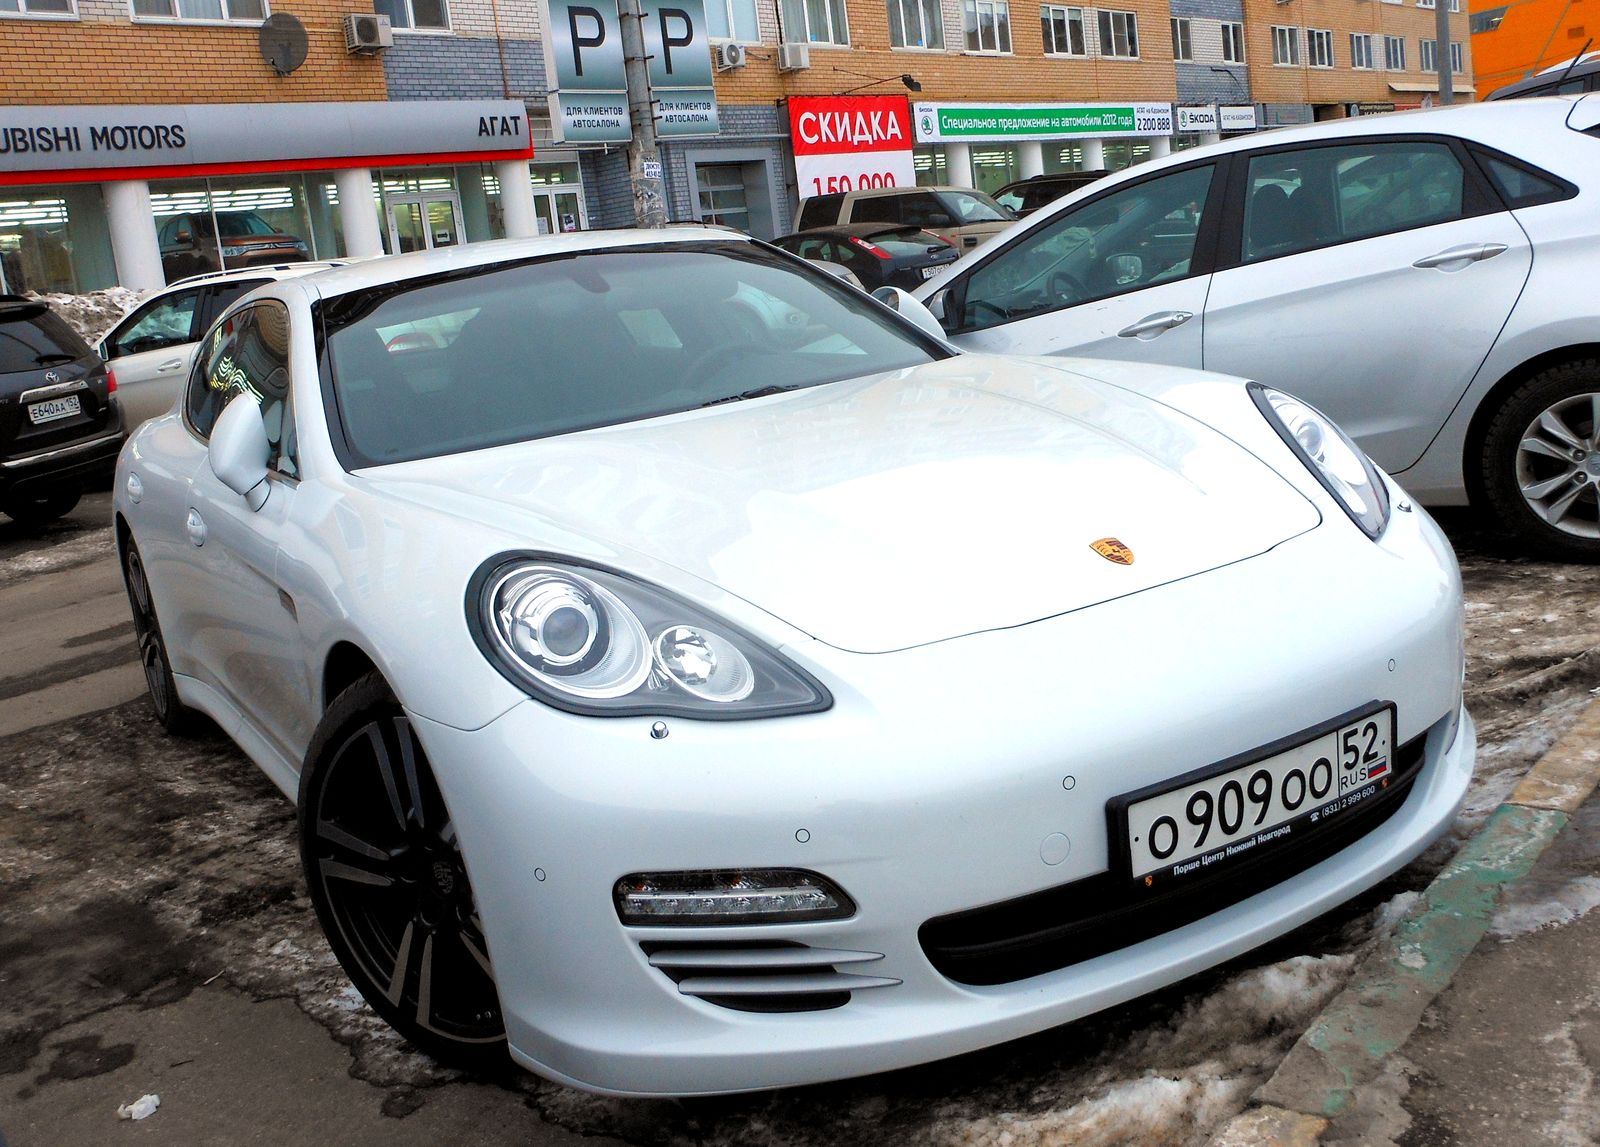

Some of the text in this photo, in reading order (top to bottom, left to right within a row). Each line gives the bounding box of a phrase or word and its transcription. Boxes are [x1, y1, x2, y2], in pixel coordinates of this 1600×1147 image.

[566, 106, 624, 117] ДЛЯ КЛИЕНТОВ
[659, 101, 712, 112] ДЛЯ КЛИЕНТОВ
[478, 115, 521, 137] АГАТ
[572, 118, 621, 129] АВТОСАЛОНА
[664, 113, 709, 124] АВТОСАЛОНА
[799, 110, 903, 146] СКИДКА
[941, 115, 997, 131] Специальное
[998, 117, 1050, 131] предложение
[1051, 117, 1060, 127] на
[1061, 113, 1102, 127] автомобили
[1102, 113, 1117, 126] 2012
[1189, 112, 1215, 124] ŠKODA
[89, 124, 188, 151] MOTORS
[1343, 721, 1379, 771] 52
[1340, 767, 1367, 791] RUS
[1321, 800, 1341, 818] (831)
[1347, 792, 1361, 805] 999
[1361, 785, 1376, 798] 600
[1173, 824, 1291, 876] Порше Центр Нижний Новгород
